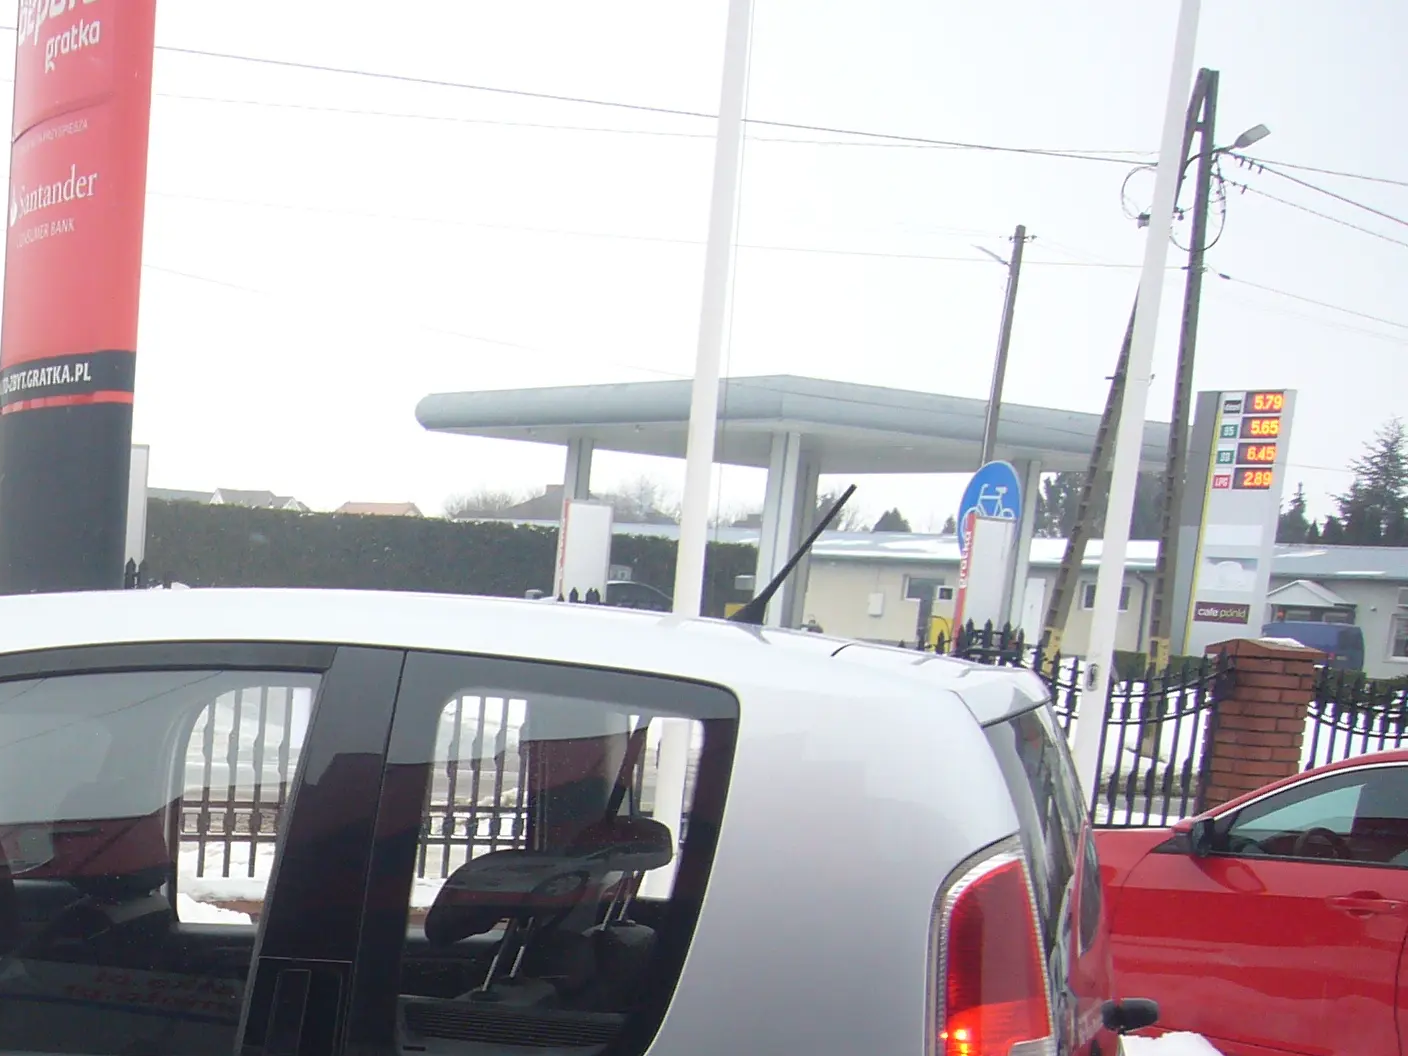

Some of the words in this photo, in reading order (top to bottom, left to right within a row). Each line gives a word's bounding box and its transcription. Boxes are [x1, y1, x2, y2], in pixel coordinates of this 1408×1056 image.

[44, 18, 100, 74] gratka
[18, 163, 97, 219] Santander
[51, 218, 75, 236] BANK
[1254, 394, 1283, 410] 5.79
[1250, 420, 1279, 435] 5.65
[1247, 446, 1276, 461] 6.45
[1214, 476, 1229, 487] LPG
[1243, 472, 1271, 486] 2.89
